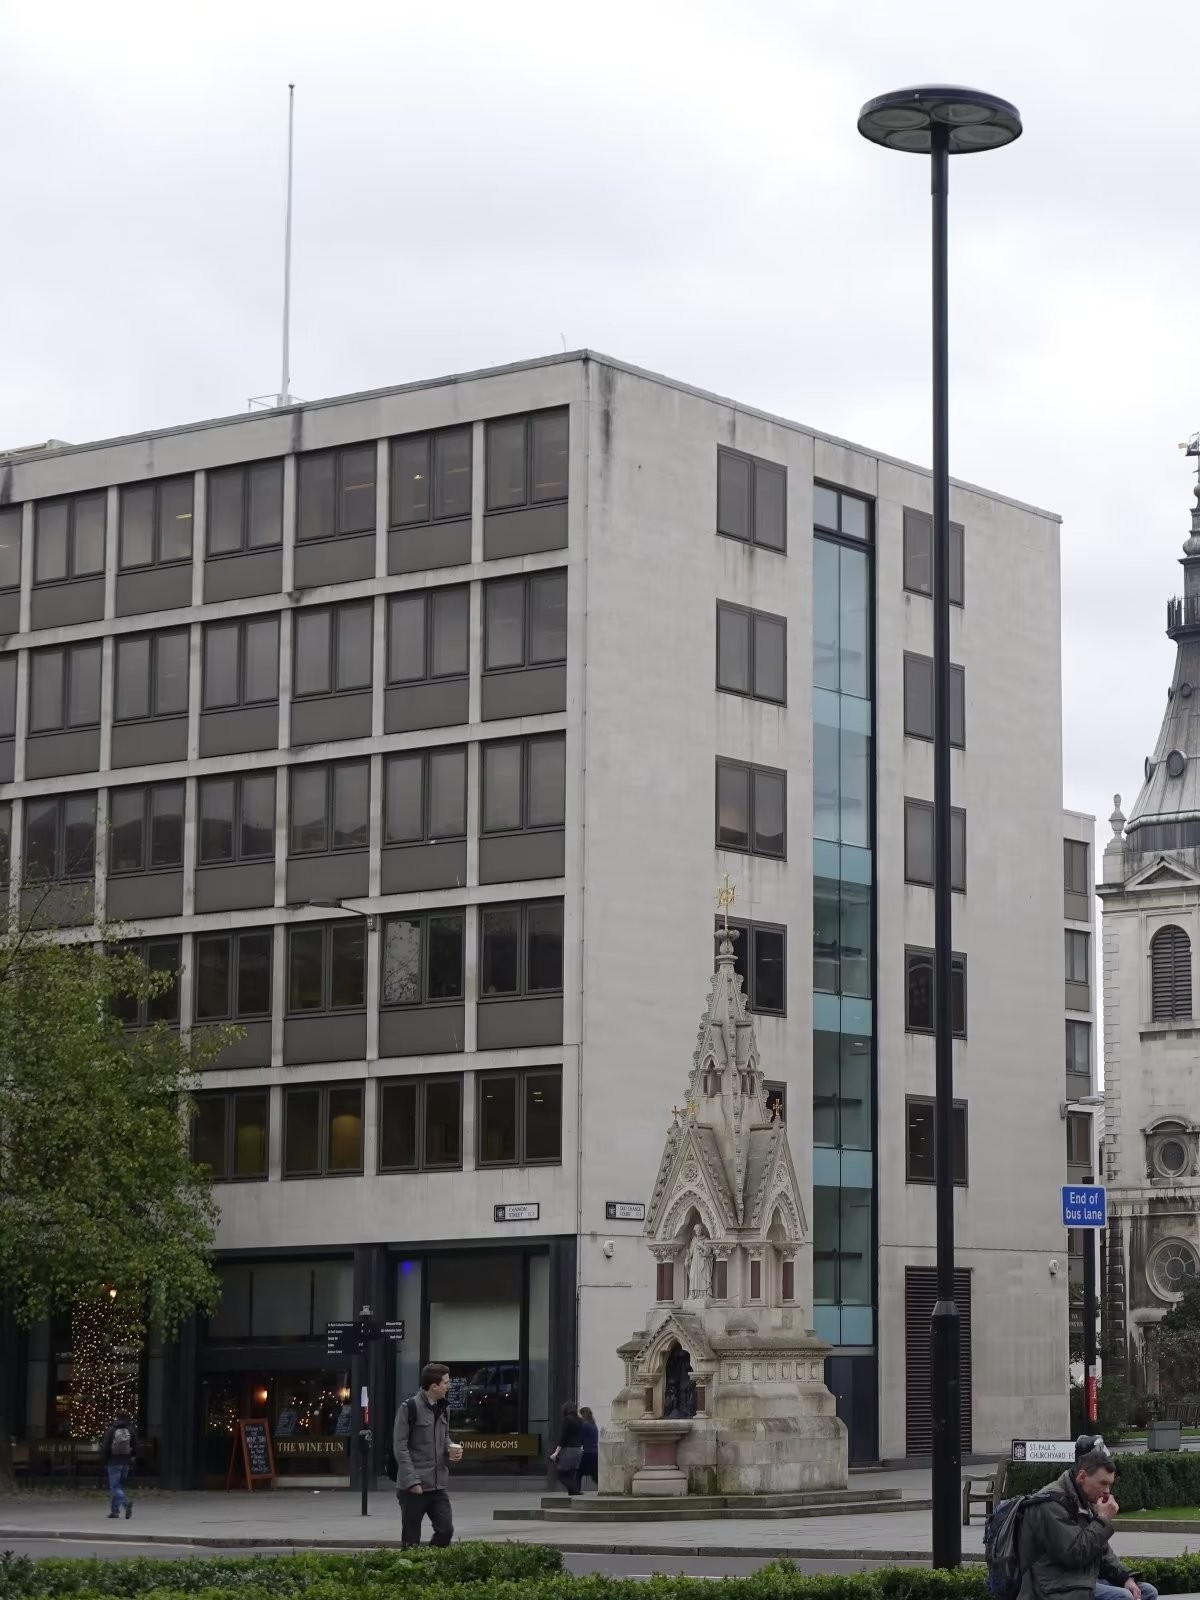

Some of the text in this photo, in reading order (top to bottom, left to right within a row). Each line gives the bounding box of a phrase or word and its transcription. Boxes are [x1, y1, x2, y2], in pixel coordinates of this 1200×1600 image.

[1070, 1192, 1098, 1204] End of
[1066, 1207, 1102, 1219] bus lane
[278, 1442, 344, 1452] THE WINE TUN
[459, 1441, 518, 1449] DINING ROOMS
